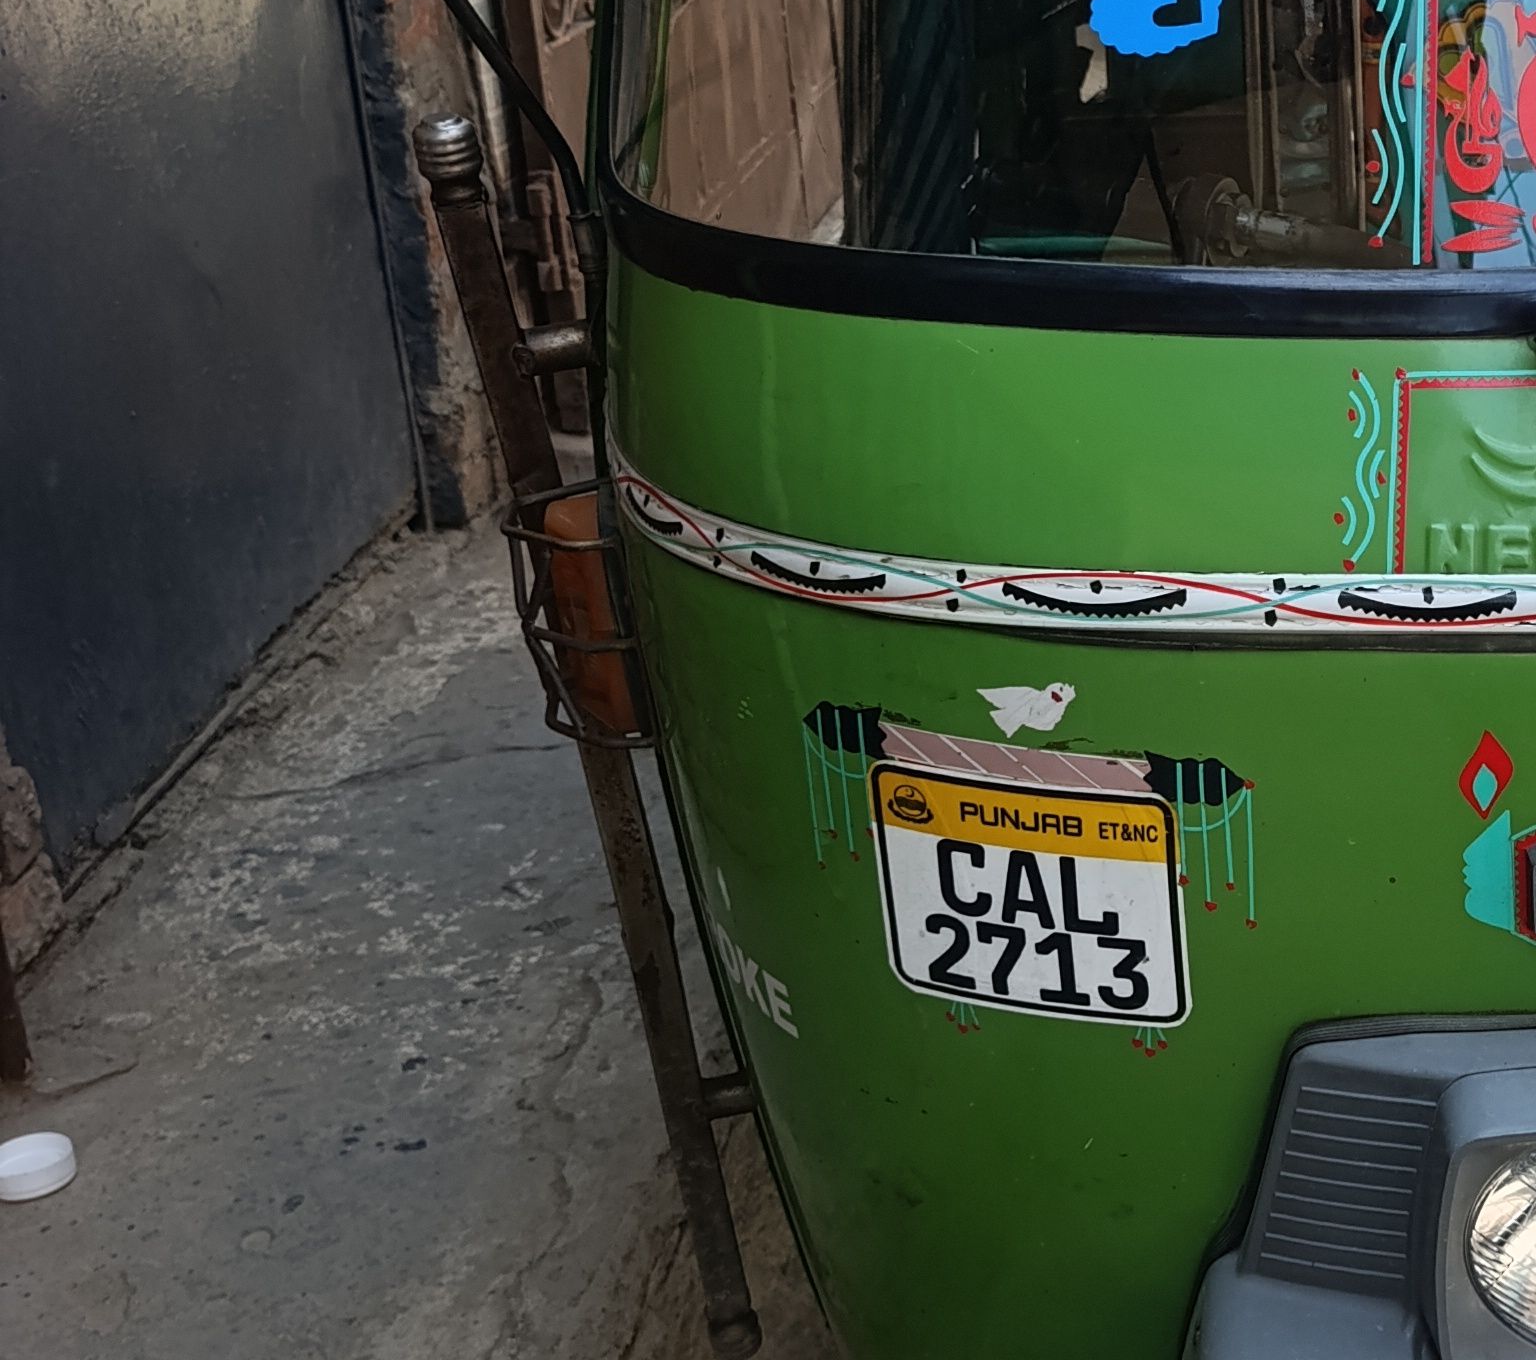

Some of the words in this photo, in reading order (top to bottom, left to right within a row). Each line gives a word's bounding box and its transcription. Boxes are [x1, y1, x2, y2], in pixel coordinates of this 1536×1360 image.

[960, 801, 1083, 838] PUNJAB
[1099, 821, 1159, 843] ET&NC
[936, 838, 1119, 936] CAL
[925, 913, 1149, 1010] 2713
